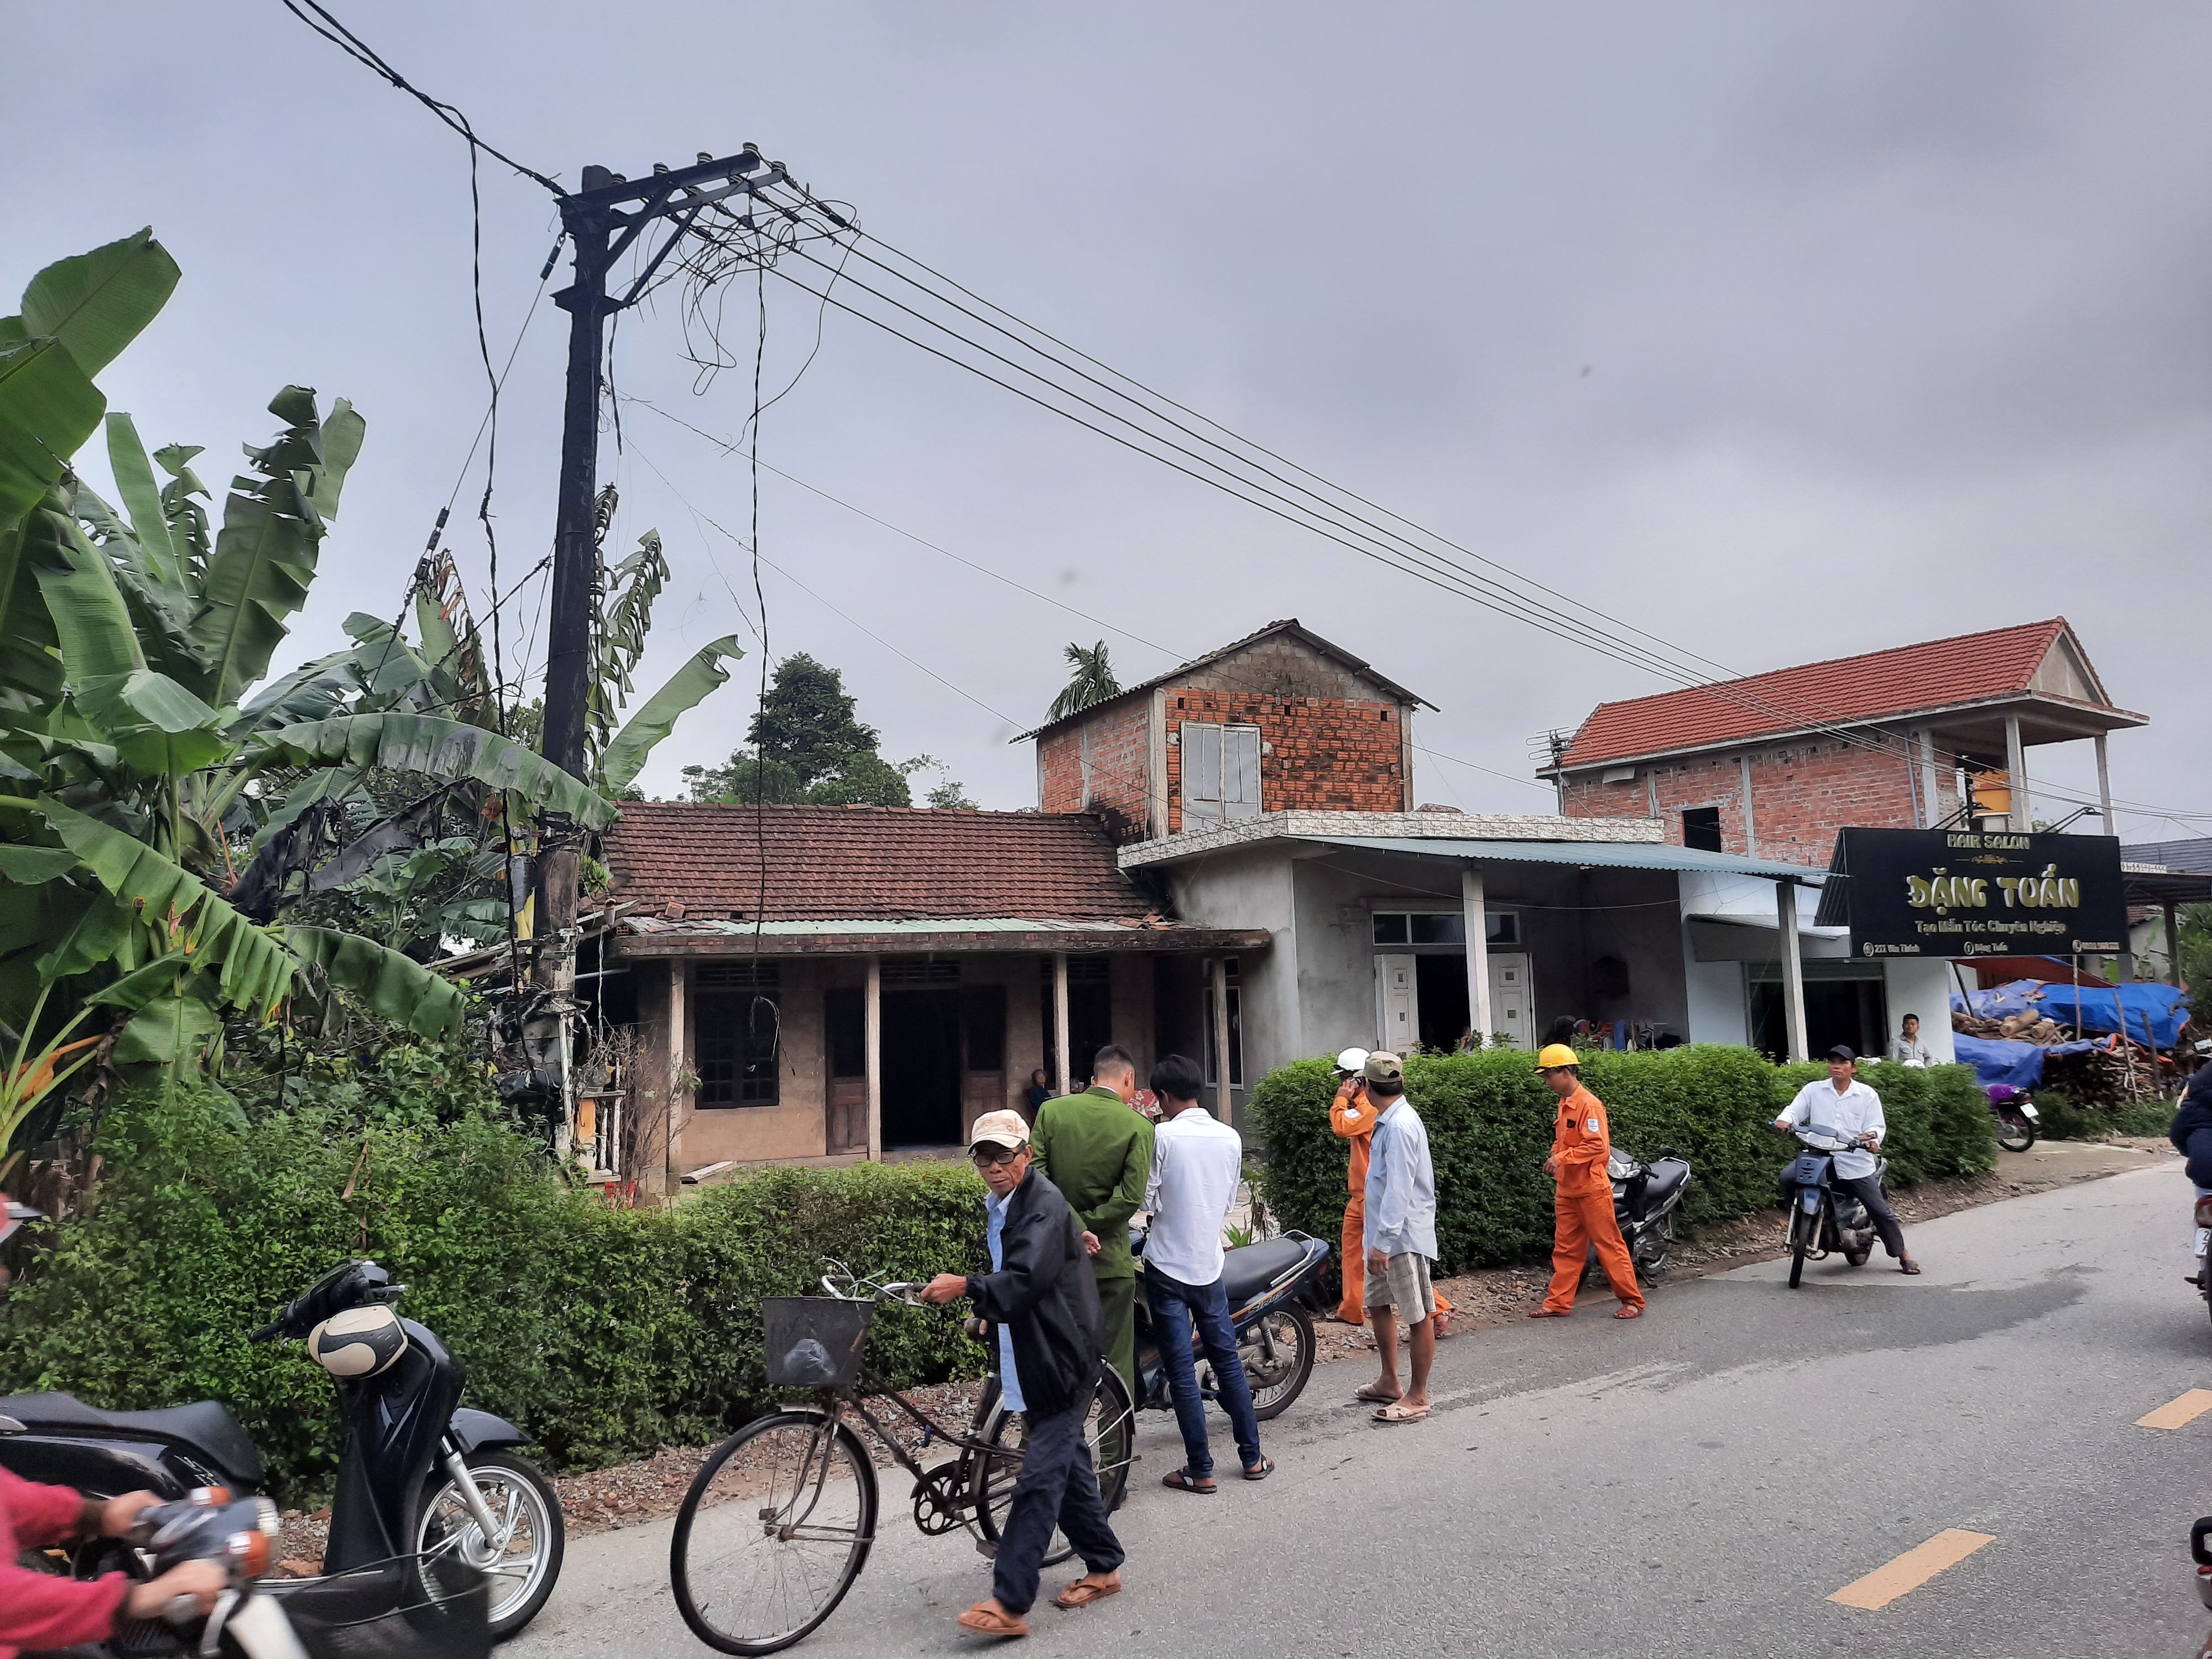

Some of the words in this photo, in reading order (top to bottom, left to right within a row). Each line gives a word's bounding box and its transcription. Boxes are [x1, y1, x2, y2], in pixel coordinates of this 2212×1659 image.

[1947, 834, 1981, 848] HAIR
[1984, 835, 2030, 850] SALON
[1906, 867, 1988, 915] ĐẶNG
[1995, 863, 2079, 907] TUẤN
[1914, 920, 1937, 936] Tạo
[1963, 920, 1986, 932] Tóc
